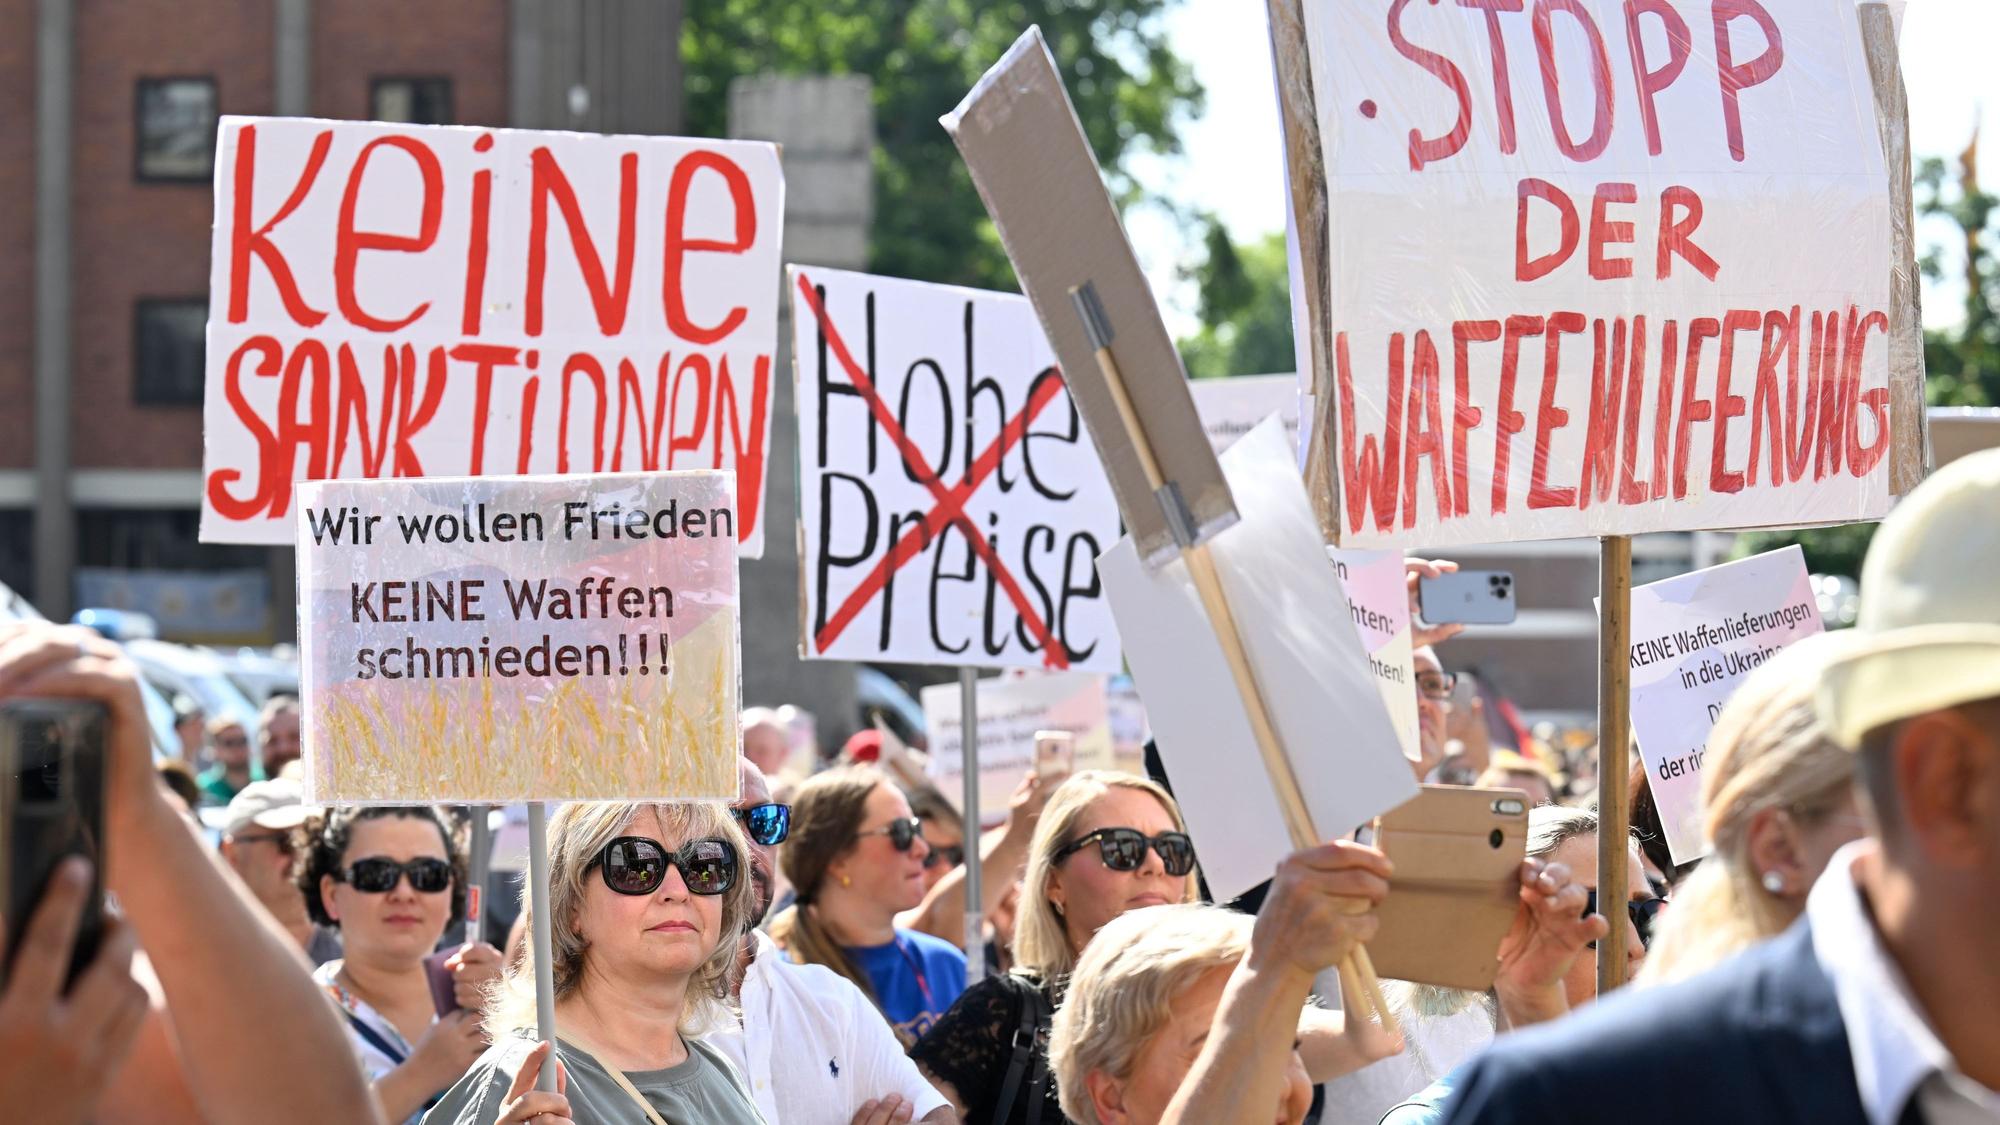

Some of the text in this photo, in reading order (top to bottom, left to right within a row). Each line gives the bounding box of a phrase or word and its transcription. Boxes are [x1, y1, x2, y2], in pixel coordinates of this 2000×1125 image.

[1388, 0, 1782, 170] STOPP
[1515, 178, 1720, 282] DER
[815, 283, 1080, 500] Hohe
[1336, 304, 1890, 535] WAFFENLIFERUNG
[306, 498, 732, 545] Wir wollen Frieden
[815, 472, 1101, 663] Preise
[351, 576, 674, 623] KEINE Waffen
[1347, 597, 1394, 636] hten:
[357, 633, 671, 680] schmieden!!!
[1629, 602, 1812, 668] KEINE Waffenlieferungen
[1367, 652, 1404, 684] hten!
[1679, 667, 1697, 689] in
[1700, 660, 1724, 683] die
[1659, 756, 1686, 780] der
